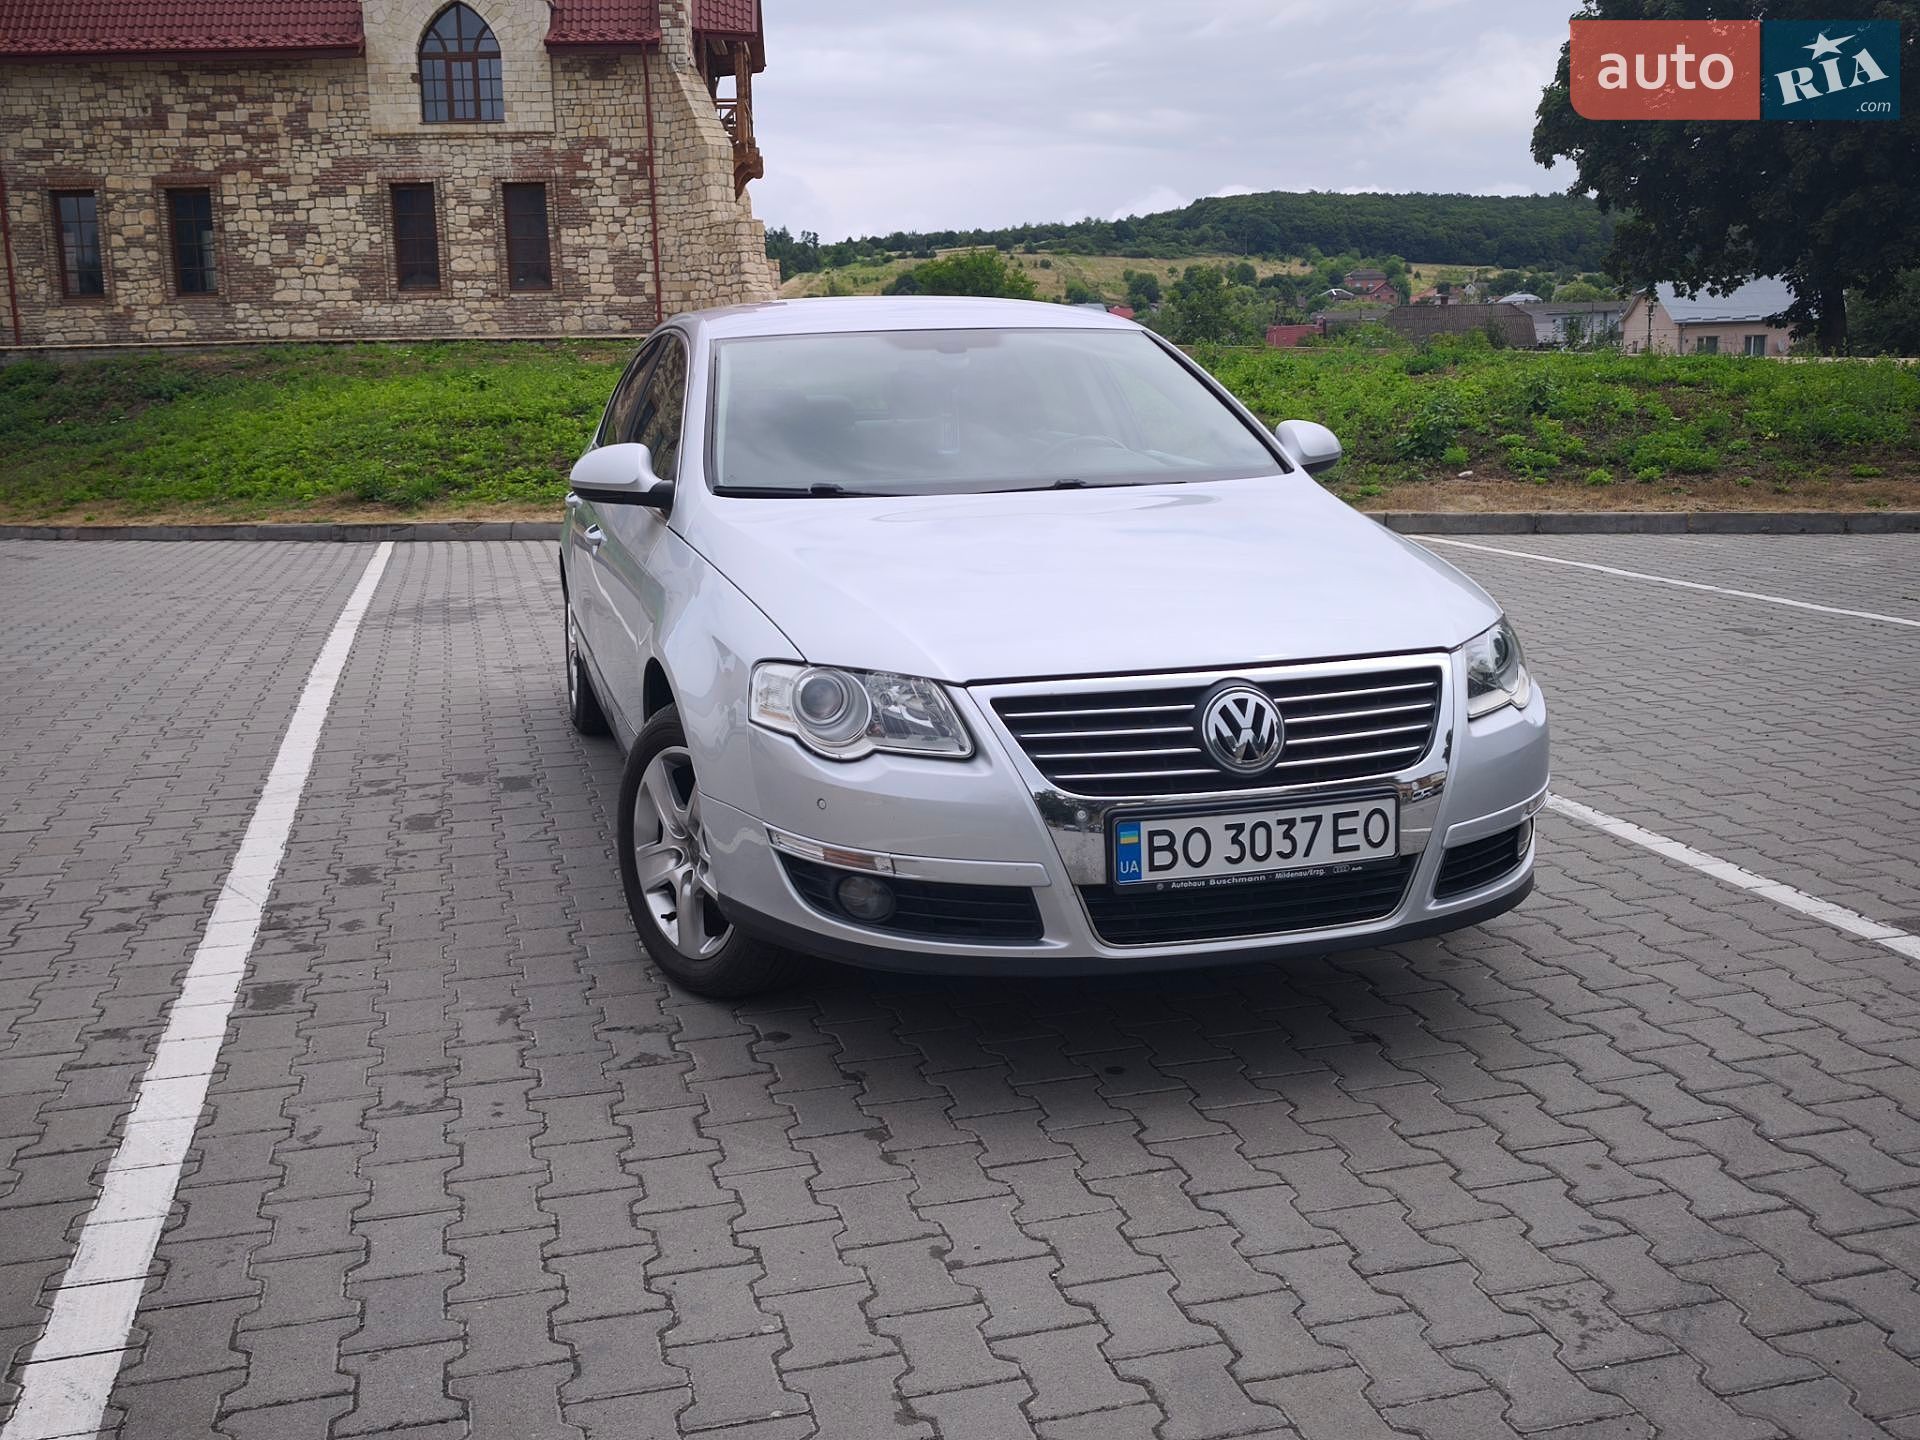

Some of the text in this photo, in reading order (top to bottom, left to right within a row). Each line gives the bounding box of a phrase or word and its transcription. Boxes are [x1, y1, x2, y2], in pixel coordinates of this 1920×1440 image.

[1206, 690, 1280, 767] VW
[1147, 807, 1390, 873] BO 3037 EO
[1119, 860, 1140, 875] UA
[1171, 880, 1206, 889] Autohaus
[1209, 874, 1267, 886] Buschmann
